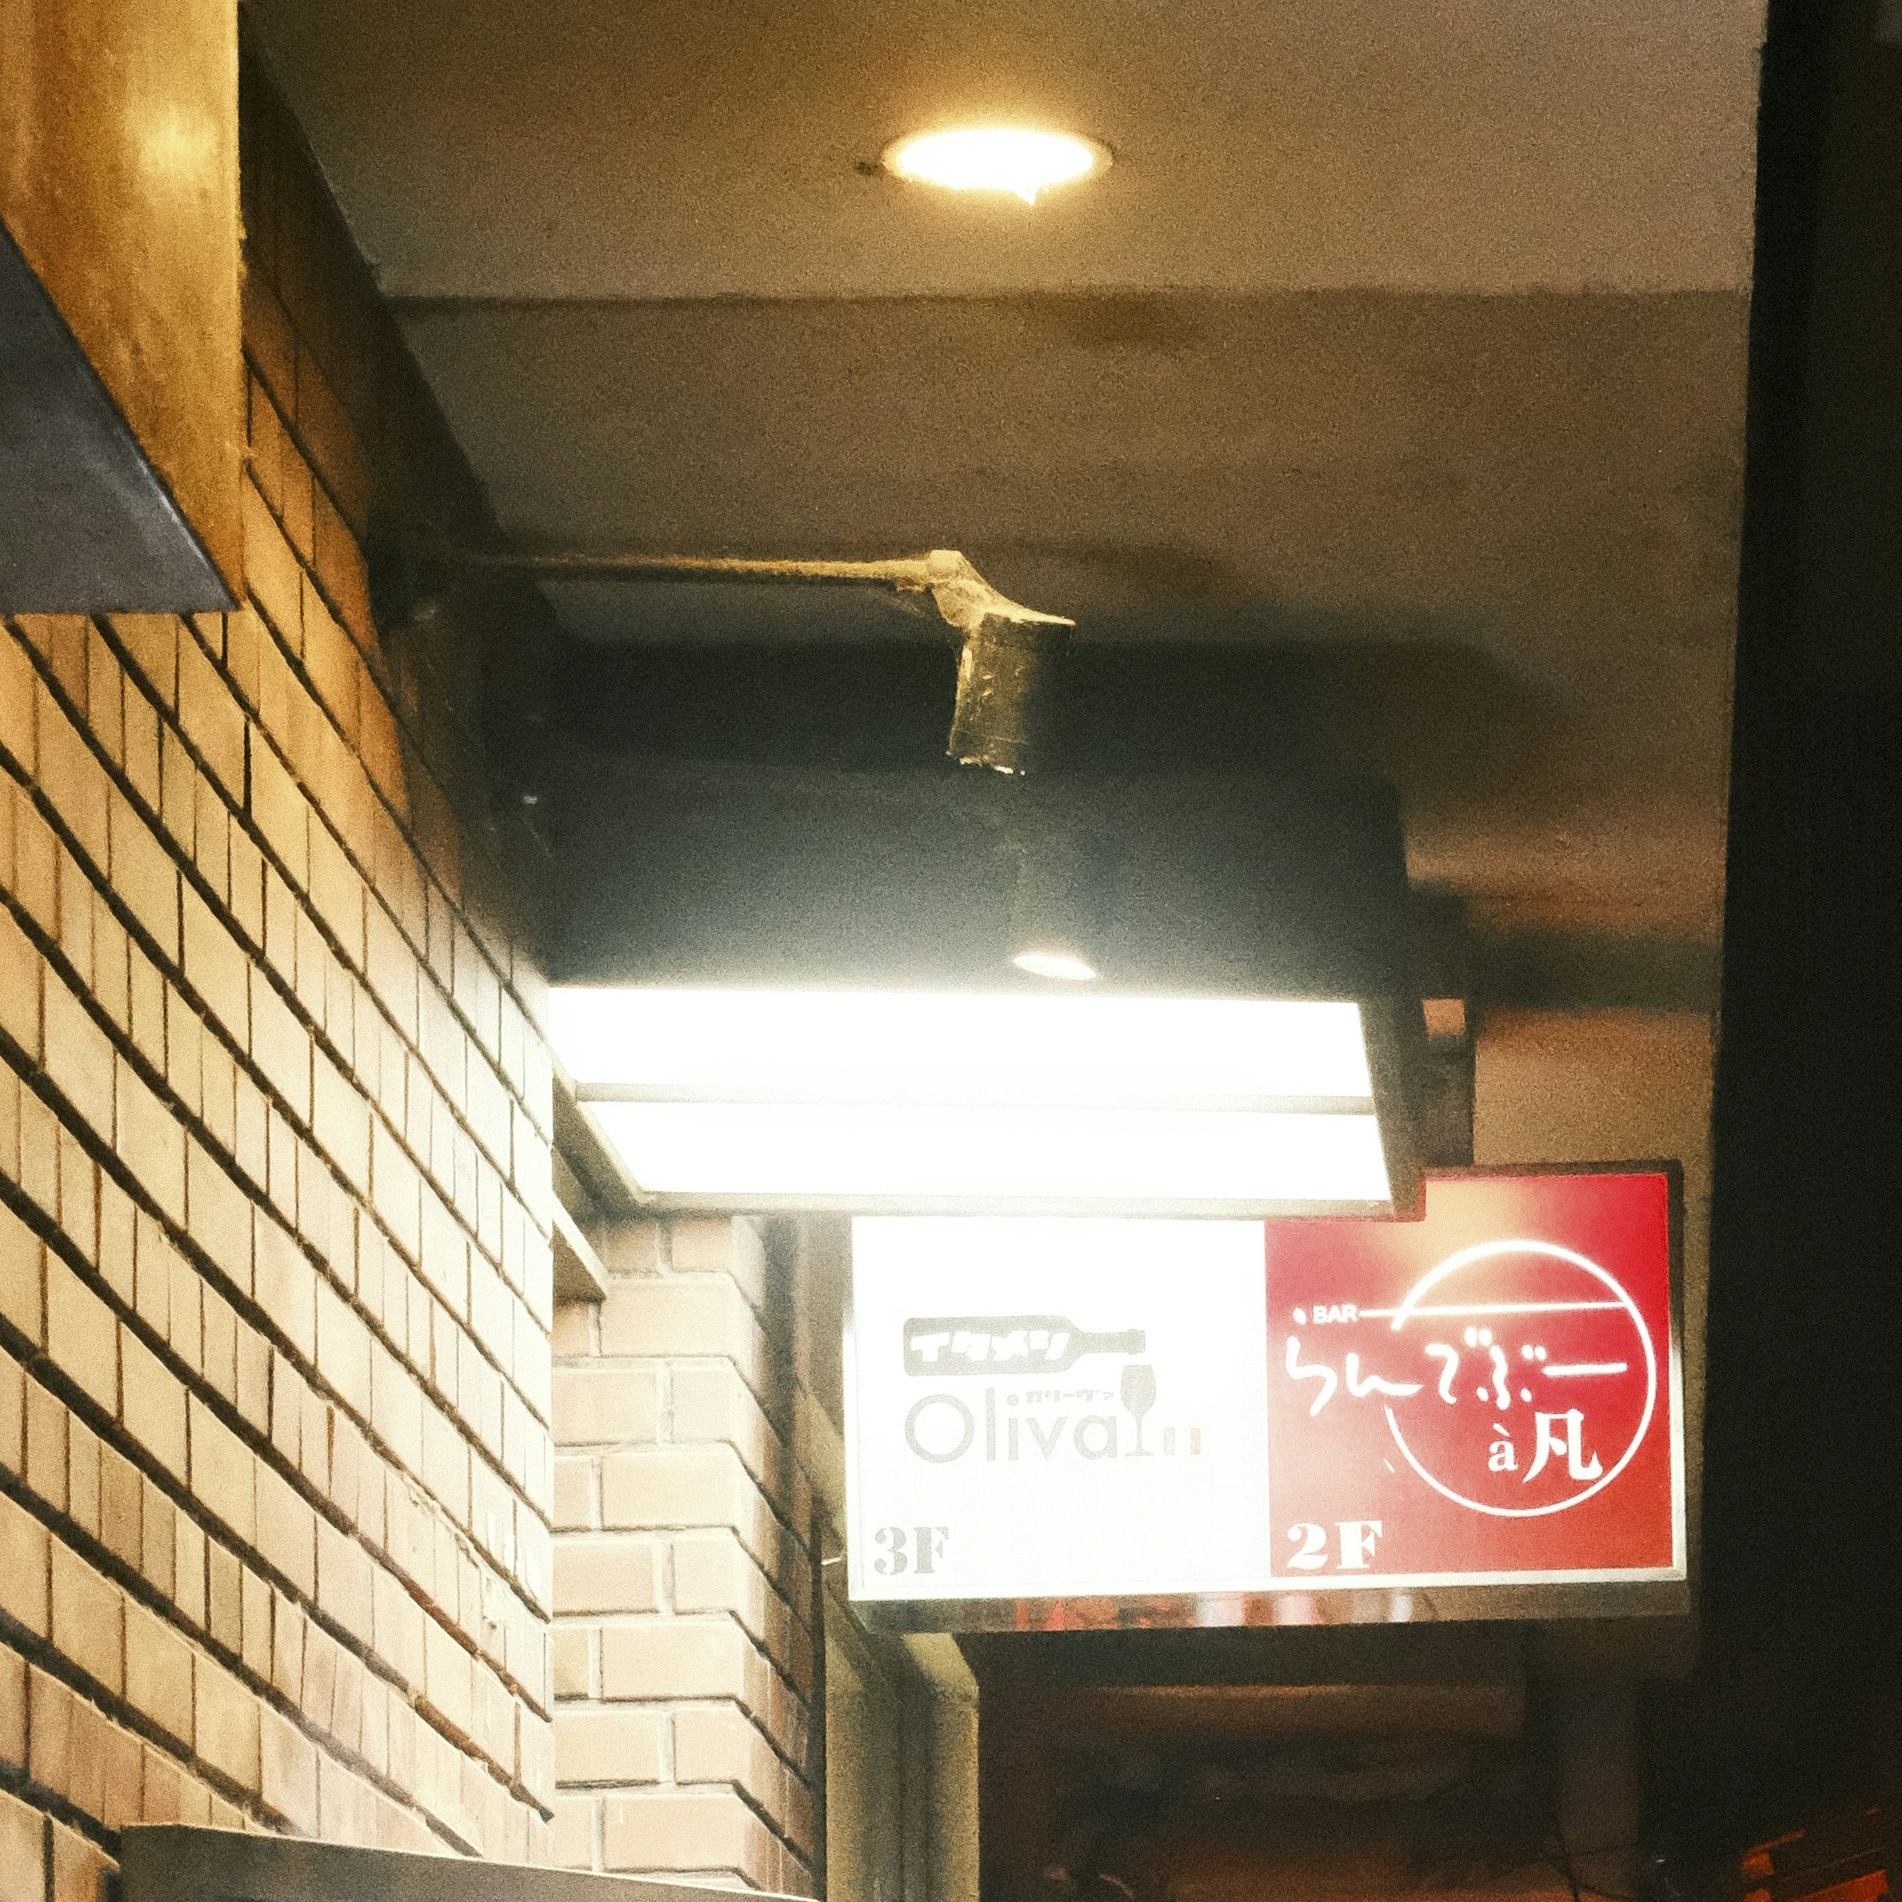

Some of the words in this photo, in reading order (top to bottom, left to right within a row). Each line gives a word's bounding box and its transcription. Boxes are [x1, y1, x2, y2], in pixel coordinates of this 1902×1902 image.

[1313, 1304, 1357, 1324] BAR
[873, 1527, 950, 1576] 3F
[1286, 1521, 1383, 1570] 2F
